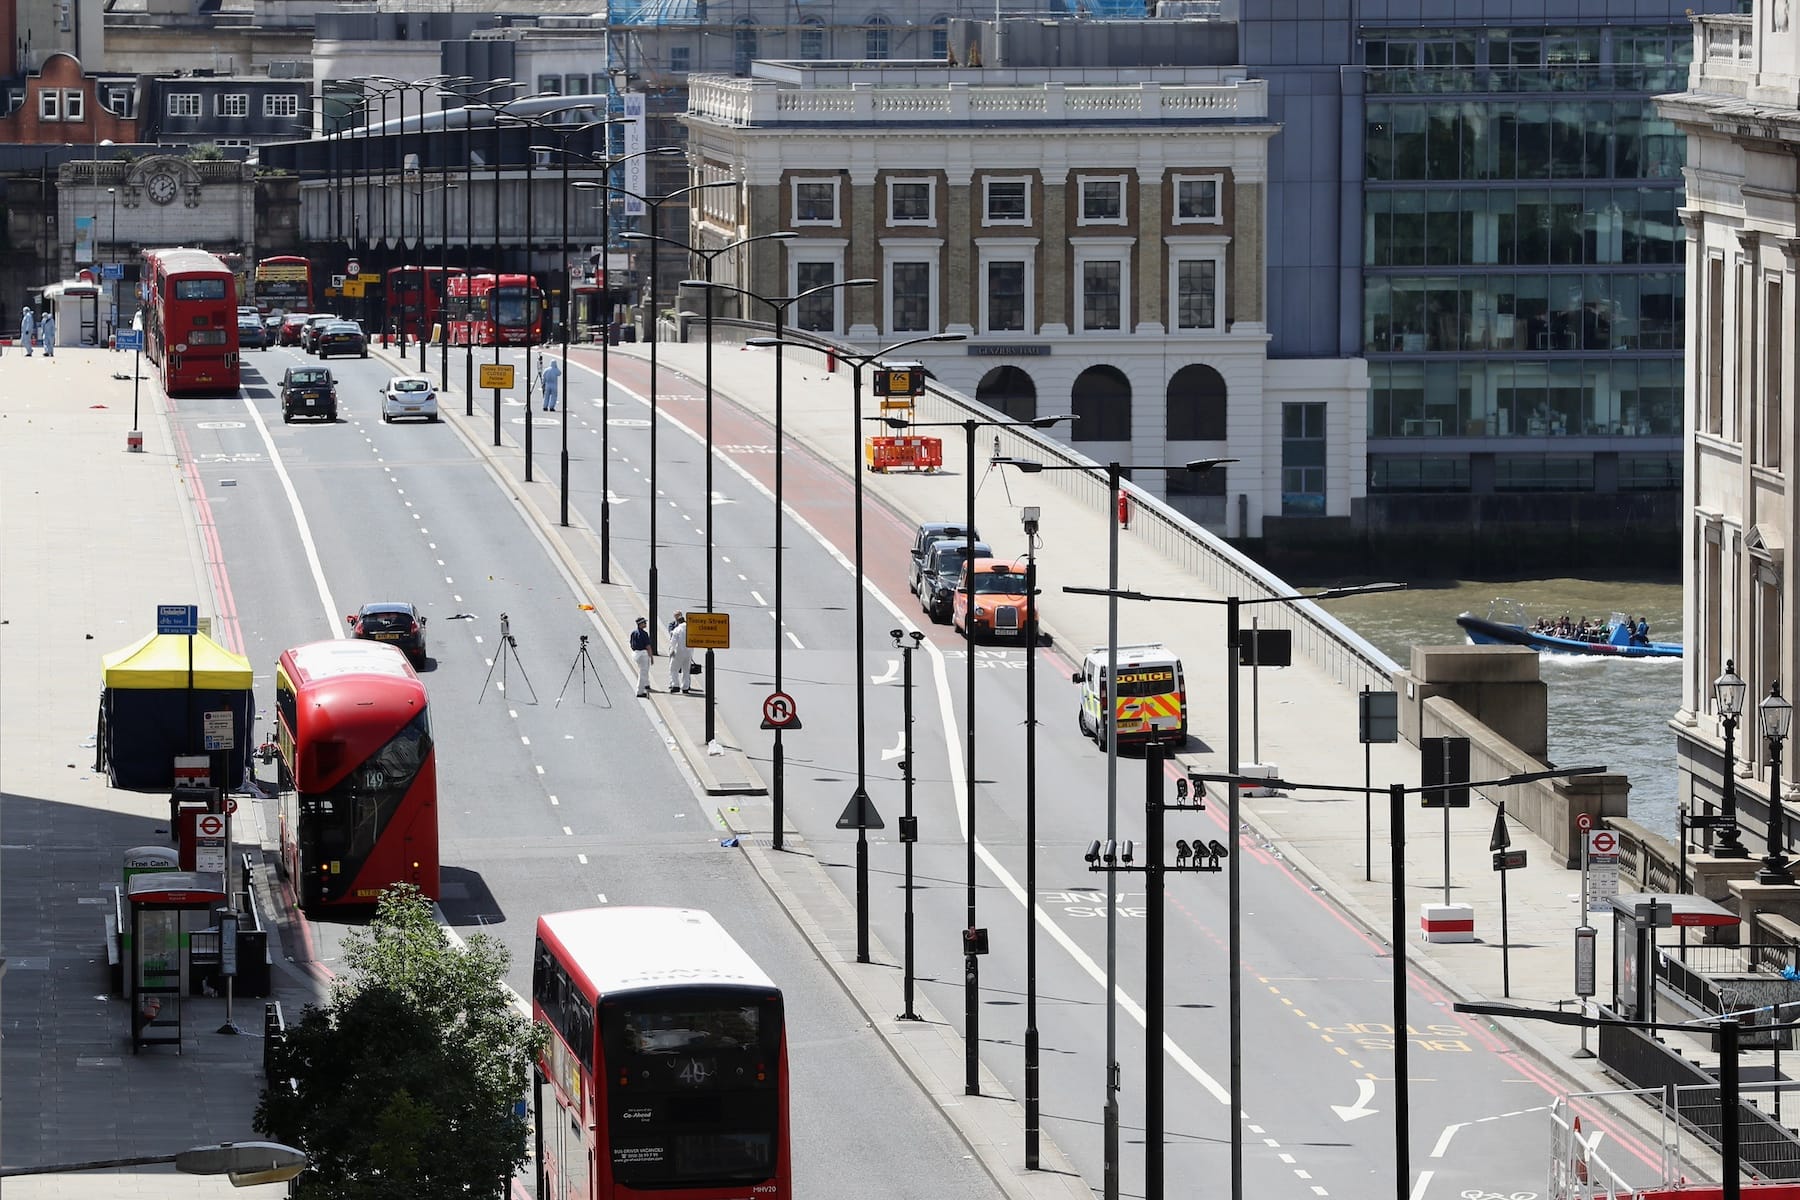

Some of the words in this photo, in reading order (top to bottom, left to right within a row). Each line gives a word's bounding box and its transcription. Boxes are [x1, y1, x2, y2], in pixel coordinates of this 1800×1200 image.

[365, 772, 384, 789] 149
[226, 800, 236, 812] P
[1579, 817, 1591, 828] Q
[1323, 1022, 1469, 1037] STOP
[1356, 1038, 1472, 1052] BUS
[622, 1111, 652, 1119] Go-Ahead
